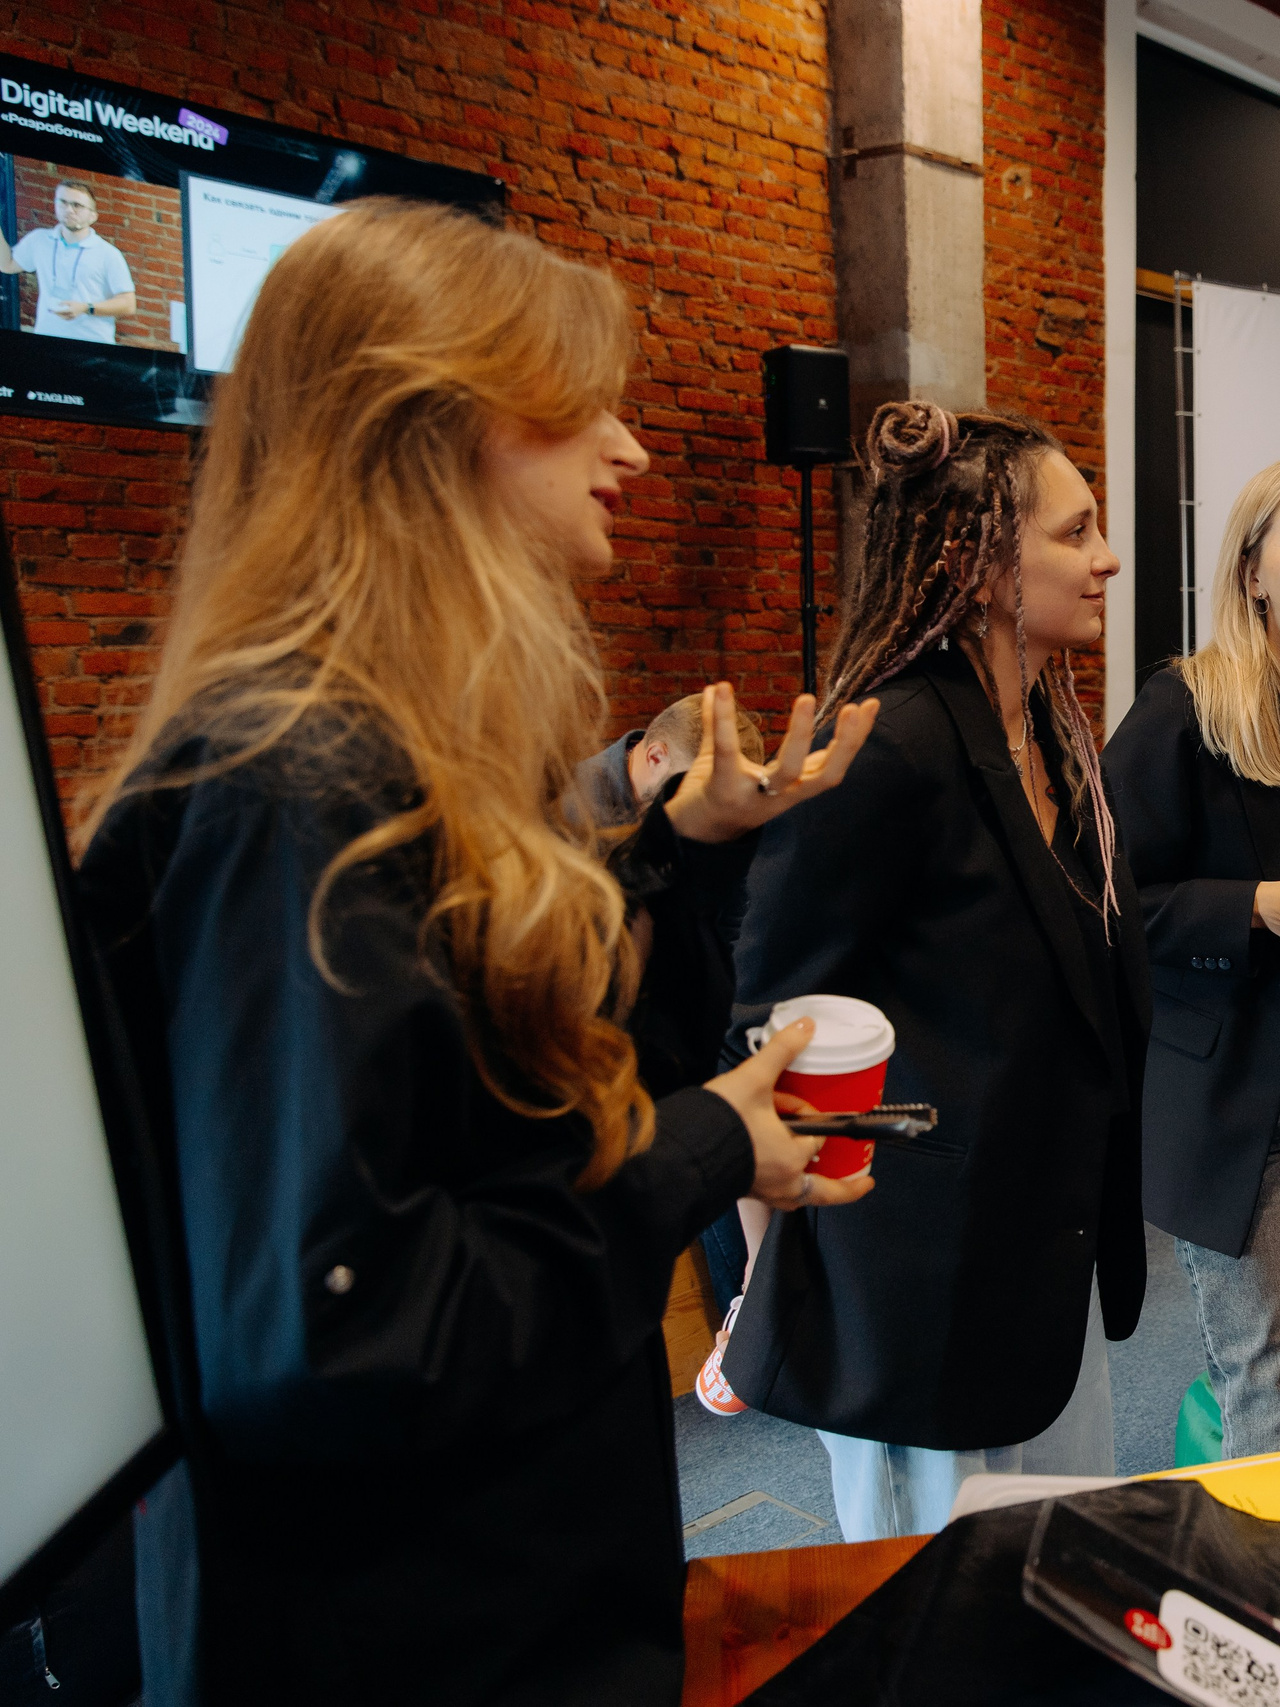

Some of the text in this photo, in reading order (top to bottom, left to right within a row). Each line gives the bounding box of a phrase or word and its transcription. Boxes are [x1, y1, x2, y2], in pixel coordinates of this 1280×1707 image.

[1, 78, 214, 151] Digital Weekend
[1, 112, 104, 143] «Разработка»
[185, 113, 221, 141] 2024
